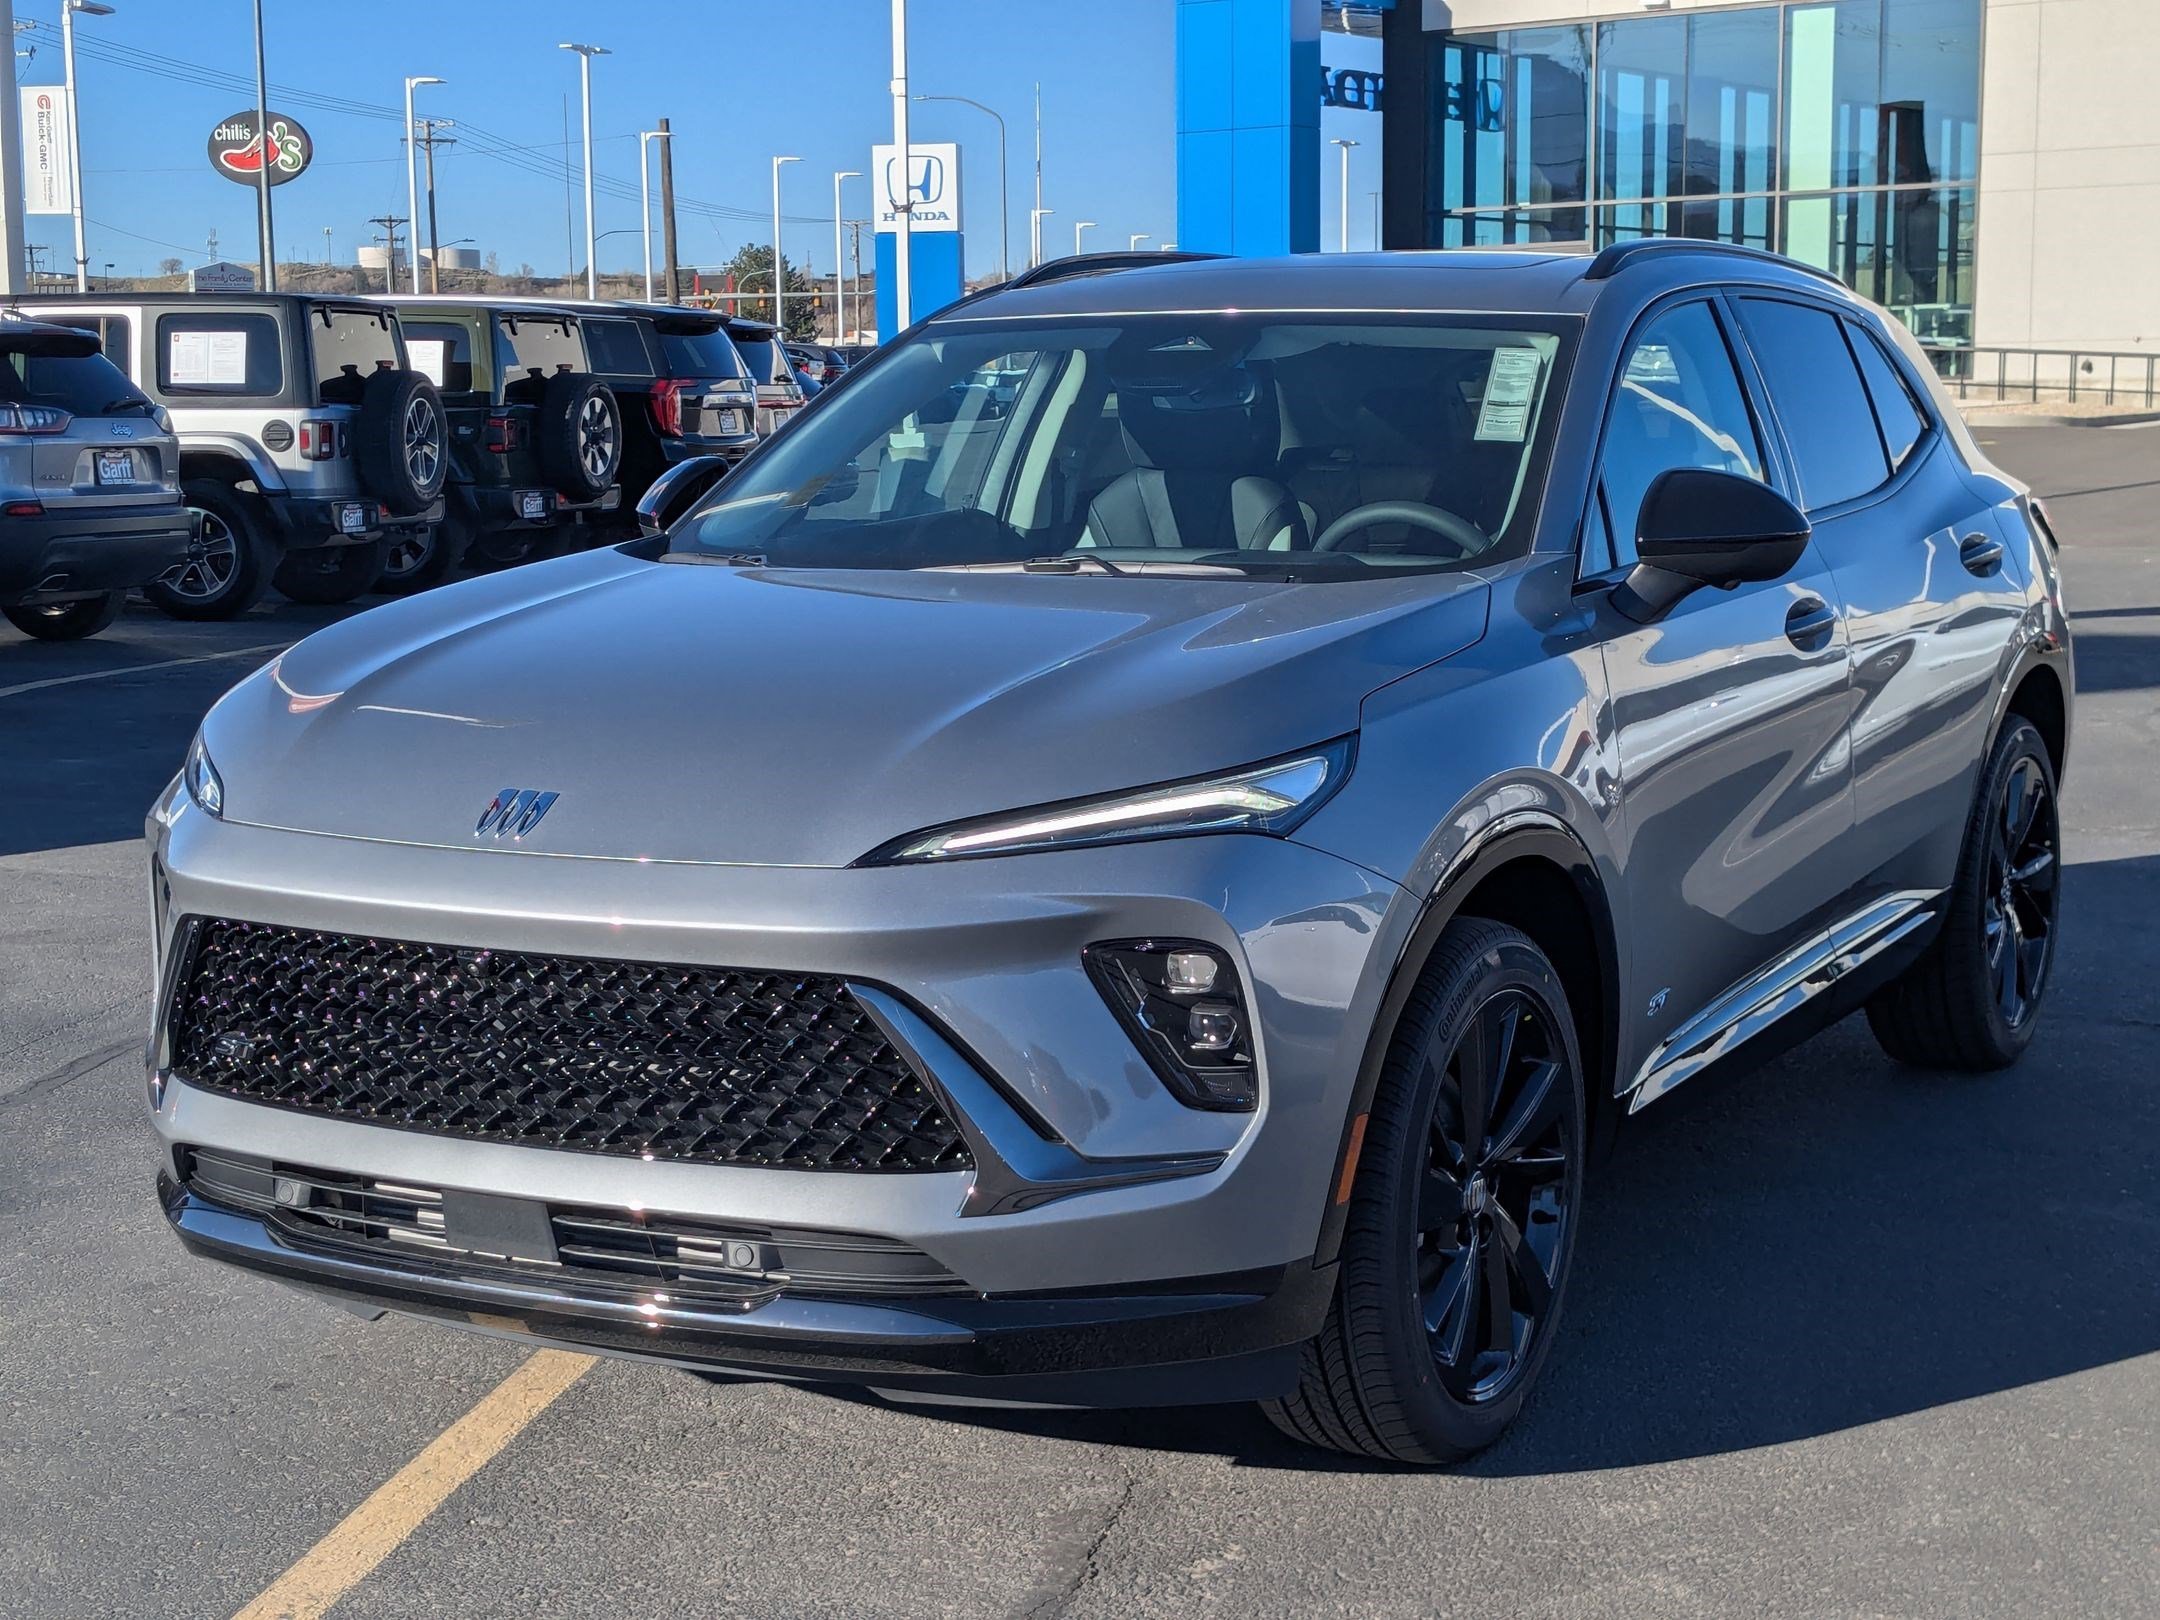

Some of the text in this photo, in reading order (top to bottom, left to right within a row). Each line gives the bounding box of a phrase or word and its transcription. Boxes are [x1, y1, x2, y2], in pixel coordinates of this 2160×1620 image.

[883, 211, 951, 221] HNDA
[112, 423, 133, 438] Jeep
[100, 458, 131, 479] Garff
[1439, 960, 1485, 1043] Continental
